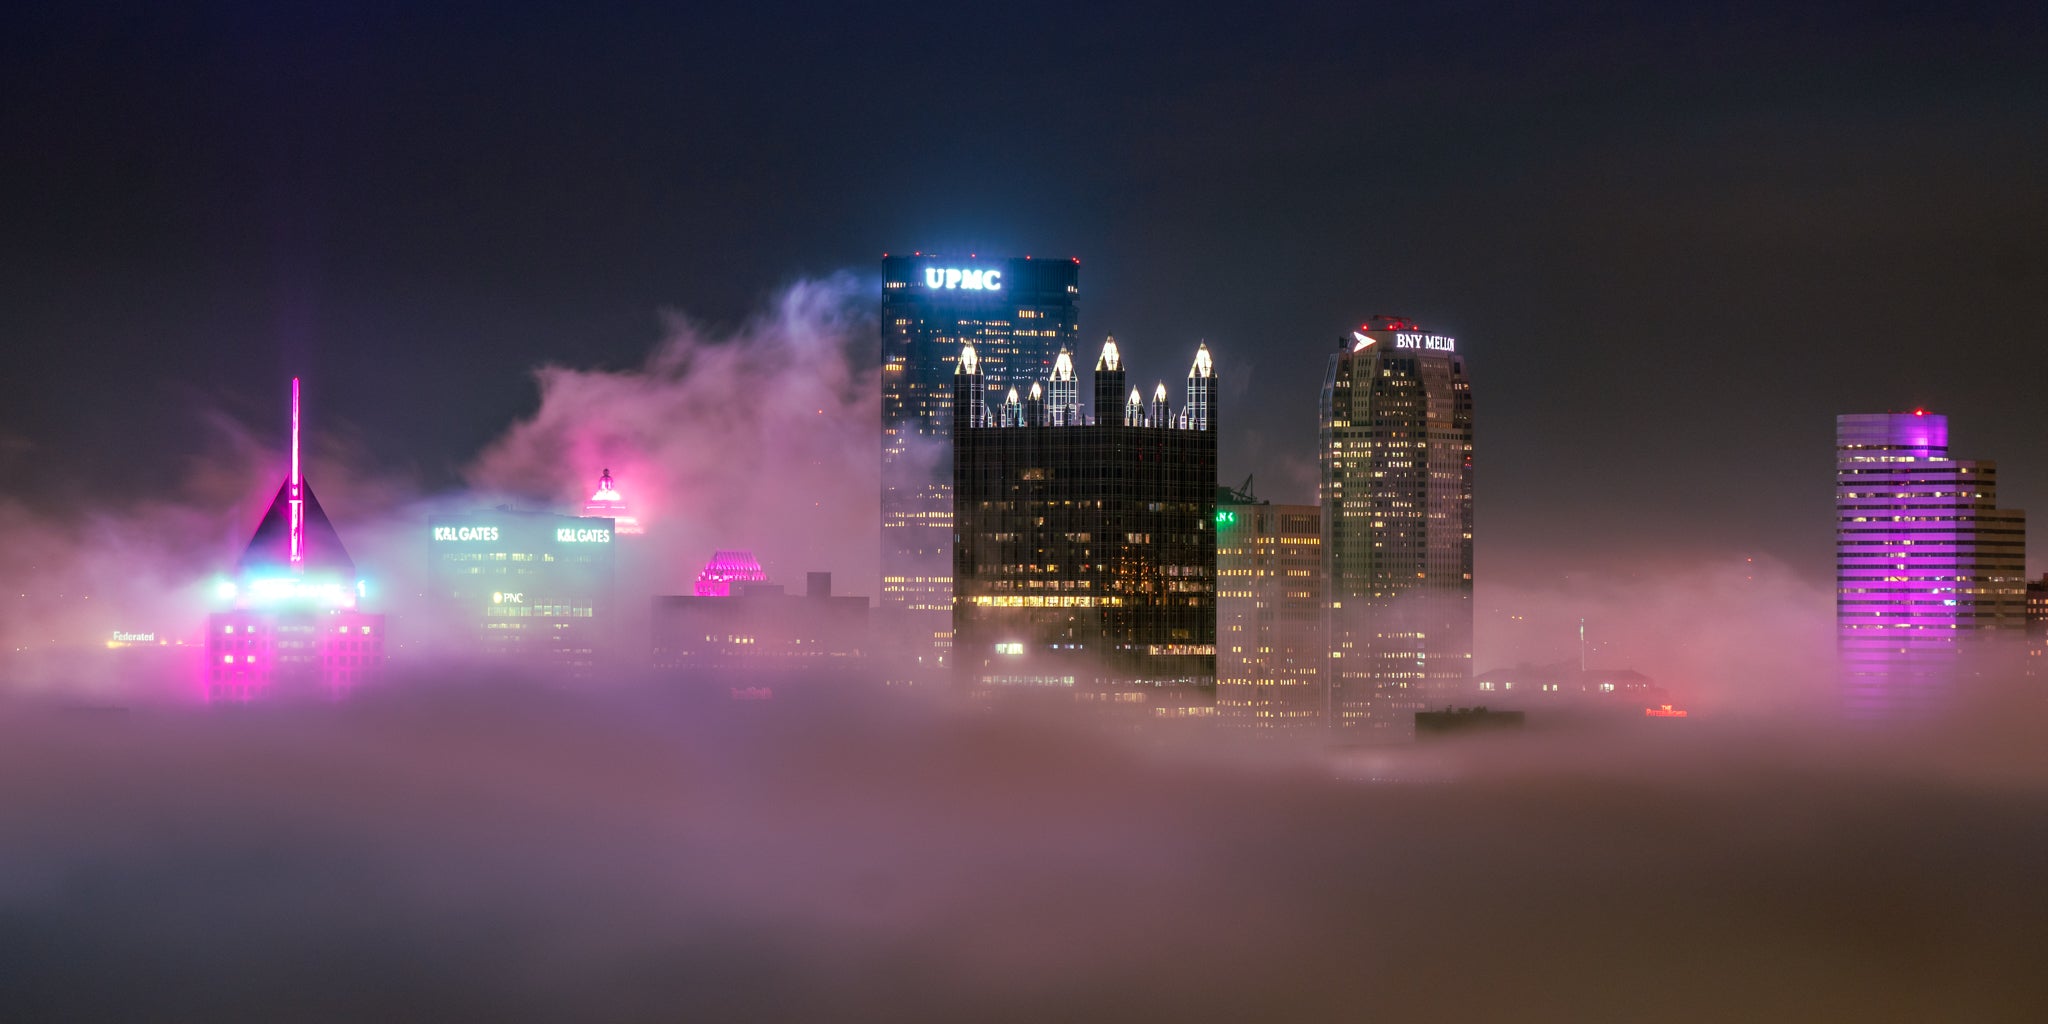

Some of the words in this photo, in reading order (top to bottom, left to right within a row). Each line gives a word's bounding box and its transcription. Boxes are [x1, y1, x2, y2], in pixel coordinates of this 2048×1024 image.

[925, 267, 1001, 291] UPMC
[1396, 333, 1423, 349] BNY
[1425, 335, 1455, 352] MELLON
[434, 527, 458, 541] K&L
[458, 527, 499, 541] GATES
[557, 528, 577, 542] K&L
[577, 529, 610, 543] GATES
[503, 592, 524, 604] PNC
[113, 631, 155, 641] Federated
